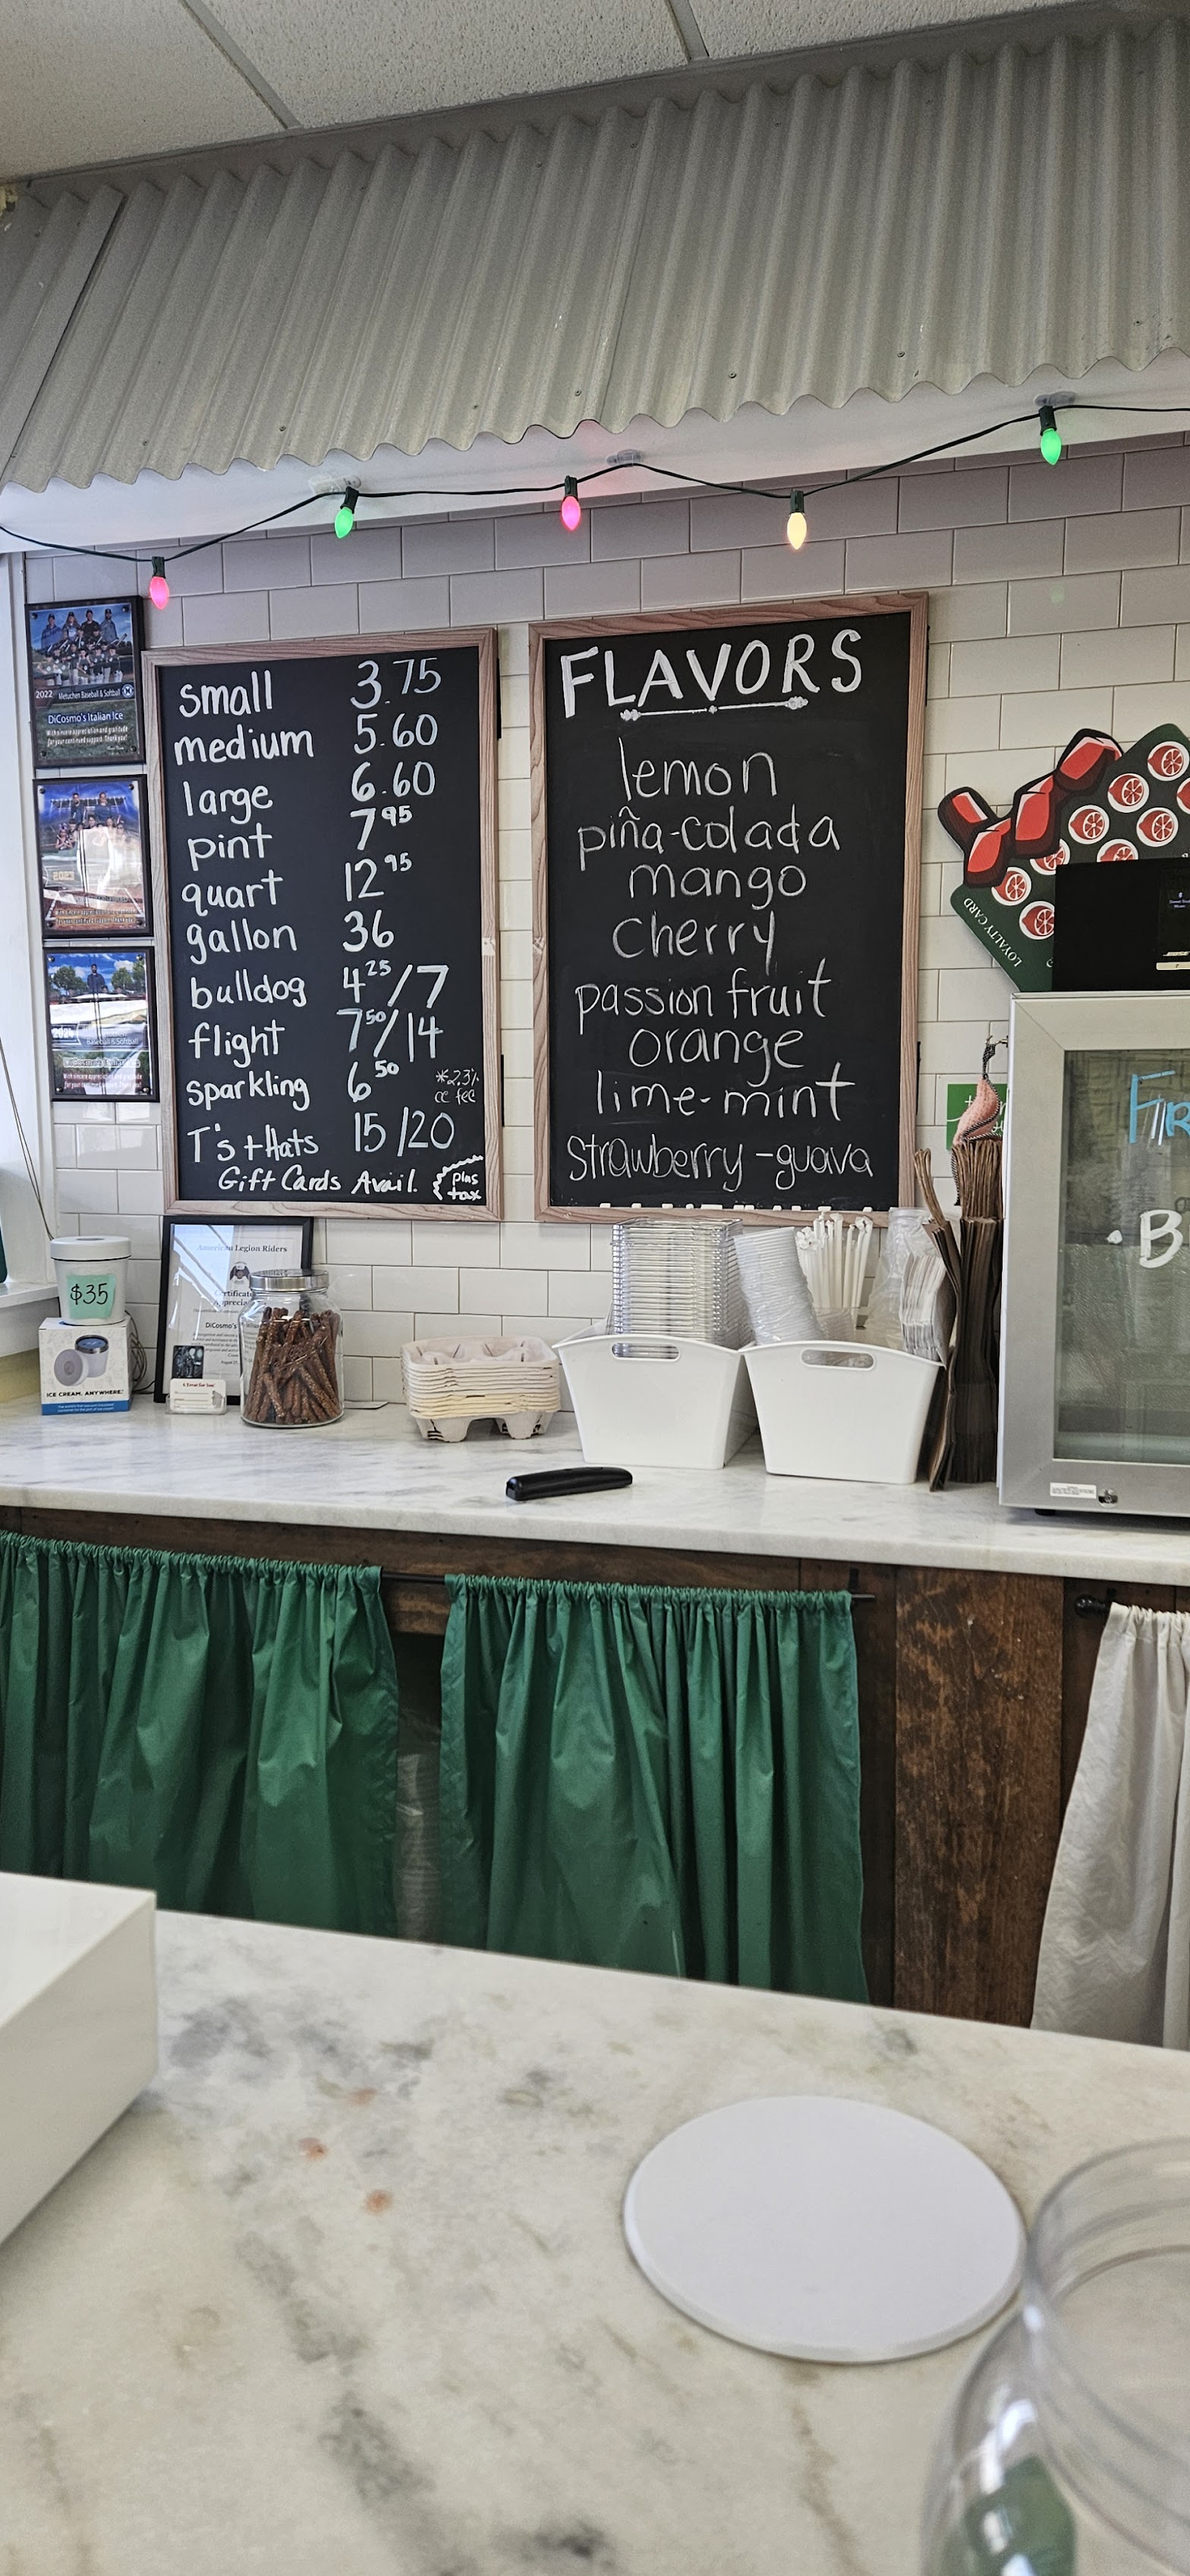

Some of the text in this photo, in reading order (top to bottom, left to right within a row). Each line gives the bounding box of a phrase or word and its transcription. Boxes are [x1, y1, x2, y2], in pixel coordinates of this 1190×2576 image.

[36, 690, 53, 699] 2022
[58, 691, 80, 701] Metuchen
[81, 690, 99, 698] Baseball
[104, 688, 121, 697] Softball
[179, 669, 273, 717] small
[350, 657, 442, 709] 3.75
[559, 628, 862, 718] FLAVORS
[48, 710, 124, 724] DiCosmo's Italian Ice
[354, 713, 438, 754] 5.60
[174, 724, 314, 765] medium
[351, 761, 435, 801] 6.60
[618, 736, 777, 801] lemon
[183, 781, 273, 824] large
[187, 823, 272, 871] pint
[578, 803, 839, 871] piña-colada
[181, 869, 283, 917] quart
[629, 863, 806, 909] mango
[187, 918, 298, 965] gallon
[342, 909, 394, 952] 36
[963, 898, 1022, 968] LOYALTY CARD
[190, 968, 307, 1009] bulldog
[575, 957, 831, 1034] passion fruit
[52, 1028, 74, 1038] 2024
[188, 1019, 285, 1068] flight
[628, 1028, 804, 1087] orange
[187, 1071, 310, 1111] sparkling
[455, 1088, 476, 1105] fee
[187, 1123, 235, 1163] T's
[265, 1124, 319, 1160] Hats
[218, 1164, 417, 1194] Gift Cards Avail.
[447, 1186, 481, 1201] tax
[452, 1171, 479, 1186] plus
[70, 1283, 109, 1305] $35
